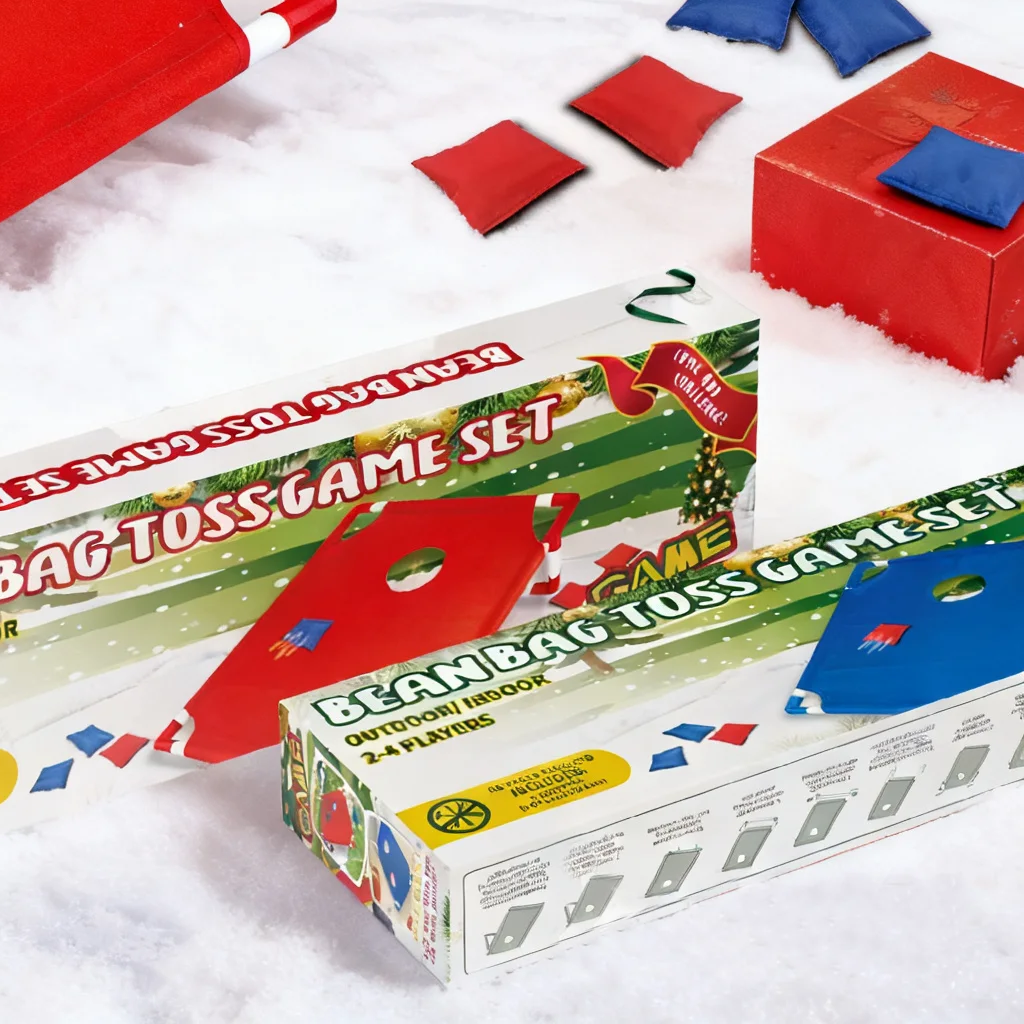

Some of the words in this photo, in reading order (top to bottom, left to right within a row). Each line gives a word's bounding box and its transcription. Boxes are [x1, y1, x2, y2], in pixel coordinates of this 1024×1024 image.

[396, 342, 523, 391] BEAN
[308, 376, 401, 413] BAG
[198, 401, 313, 447] TOSS
[70, 432, 201, 484] GAME
[120, 480, 274, 564] TOSS
[278, 430, 451, 519] GAME
[459, 393, 562, 465] SET
[312, 655, 494, 726] BEAN
[481, 618, 612, 673] BAG
[608, 571, 761, 629] TOSS
[751, 519, 926, 583] GAME
[915, 483, 1020, 532] SET
